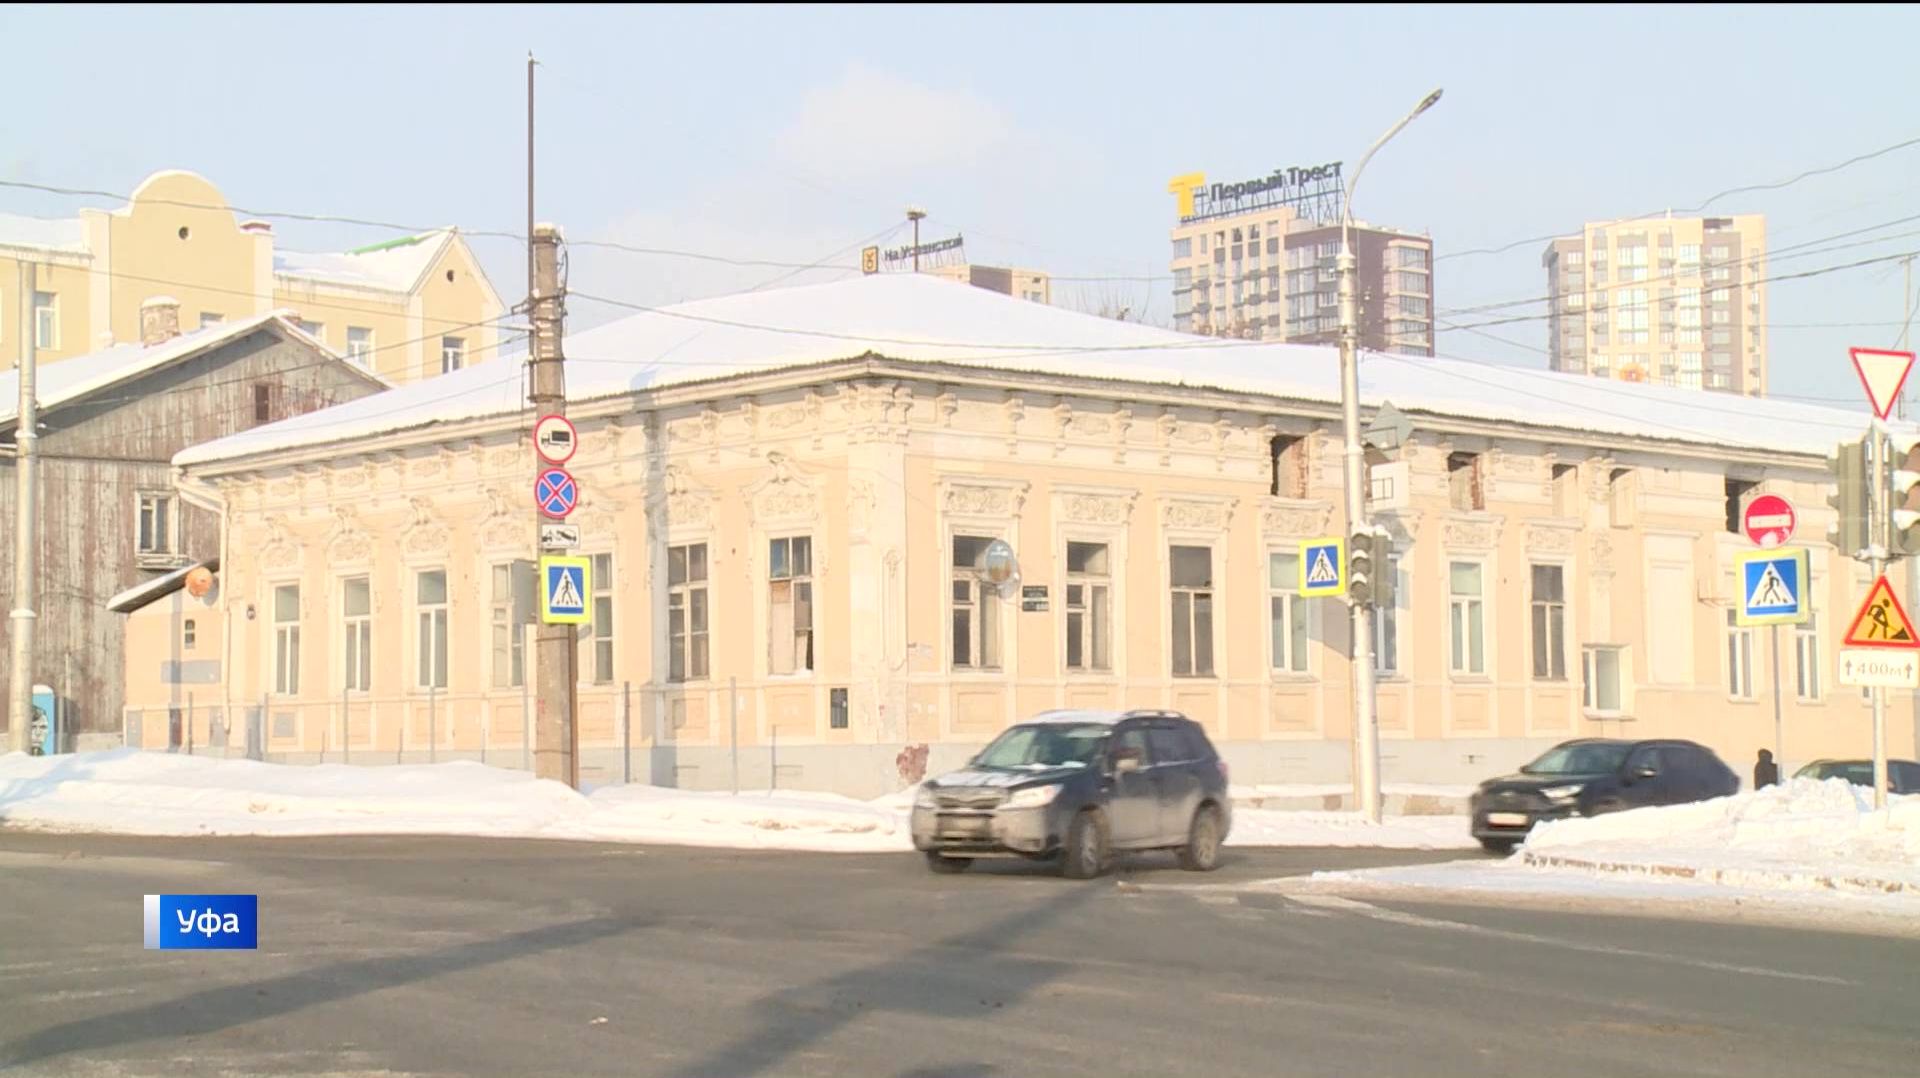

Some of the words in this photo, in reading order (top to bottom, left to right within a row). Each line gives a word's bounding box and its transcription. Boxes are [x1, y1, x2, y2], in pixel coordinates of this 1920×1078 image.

[1210, 169, 1285, 201] Первый
[1287, 161, 1343, 187] Трест
[884, 249, 899, 261] На
